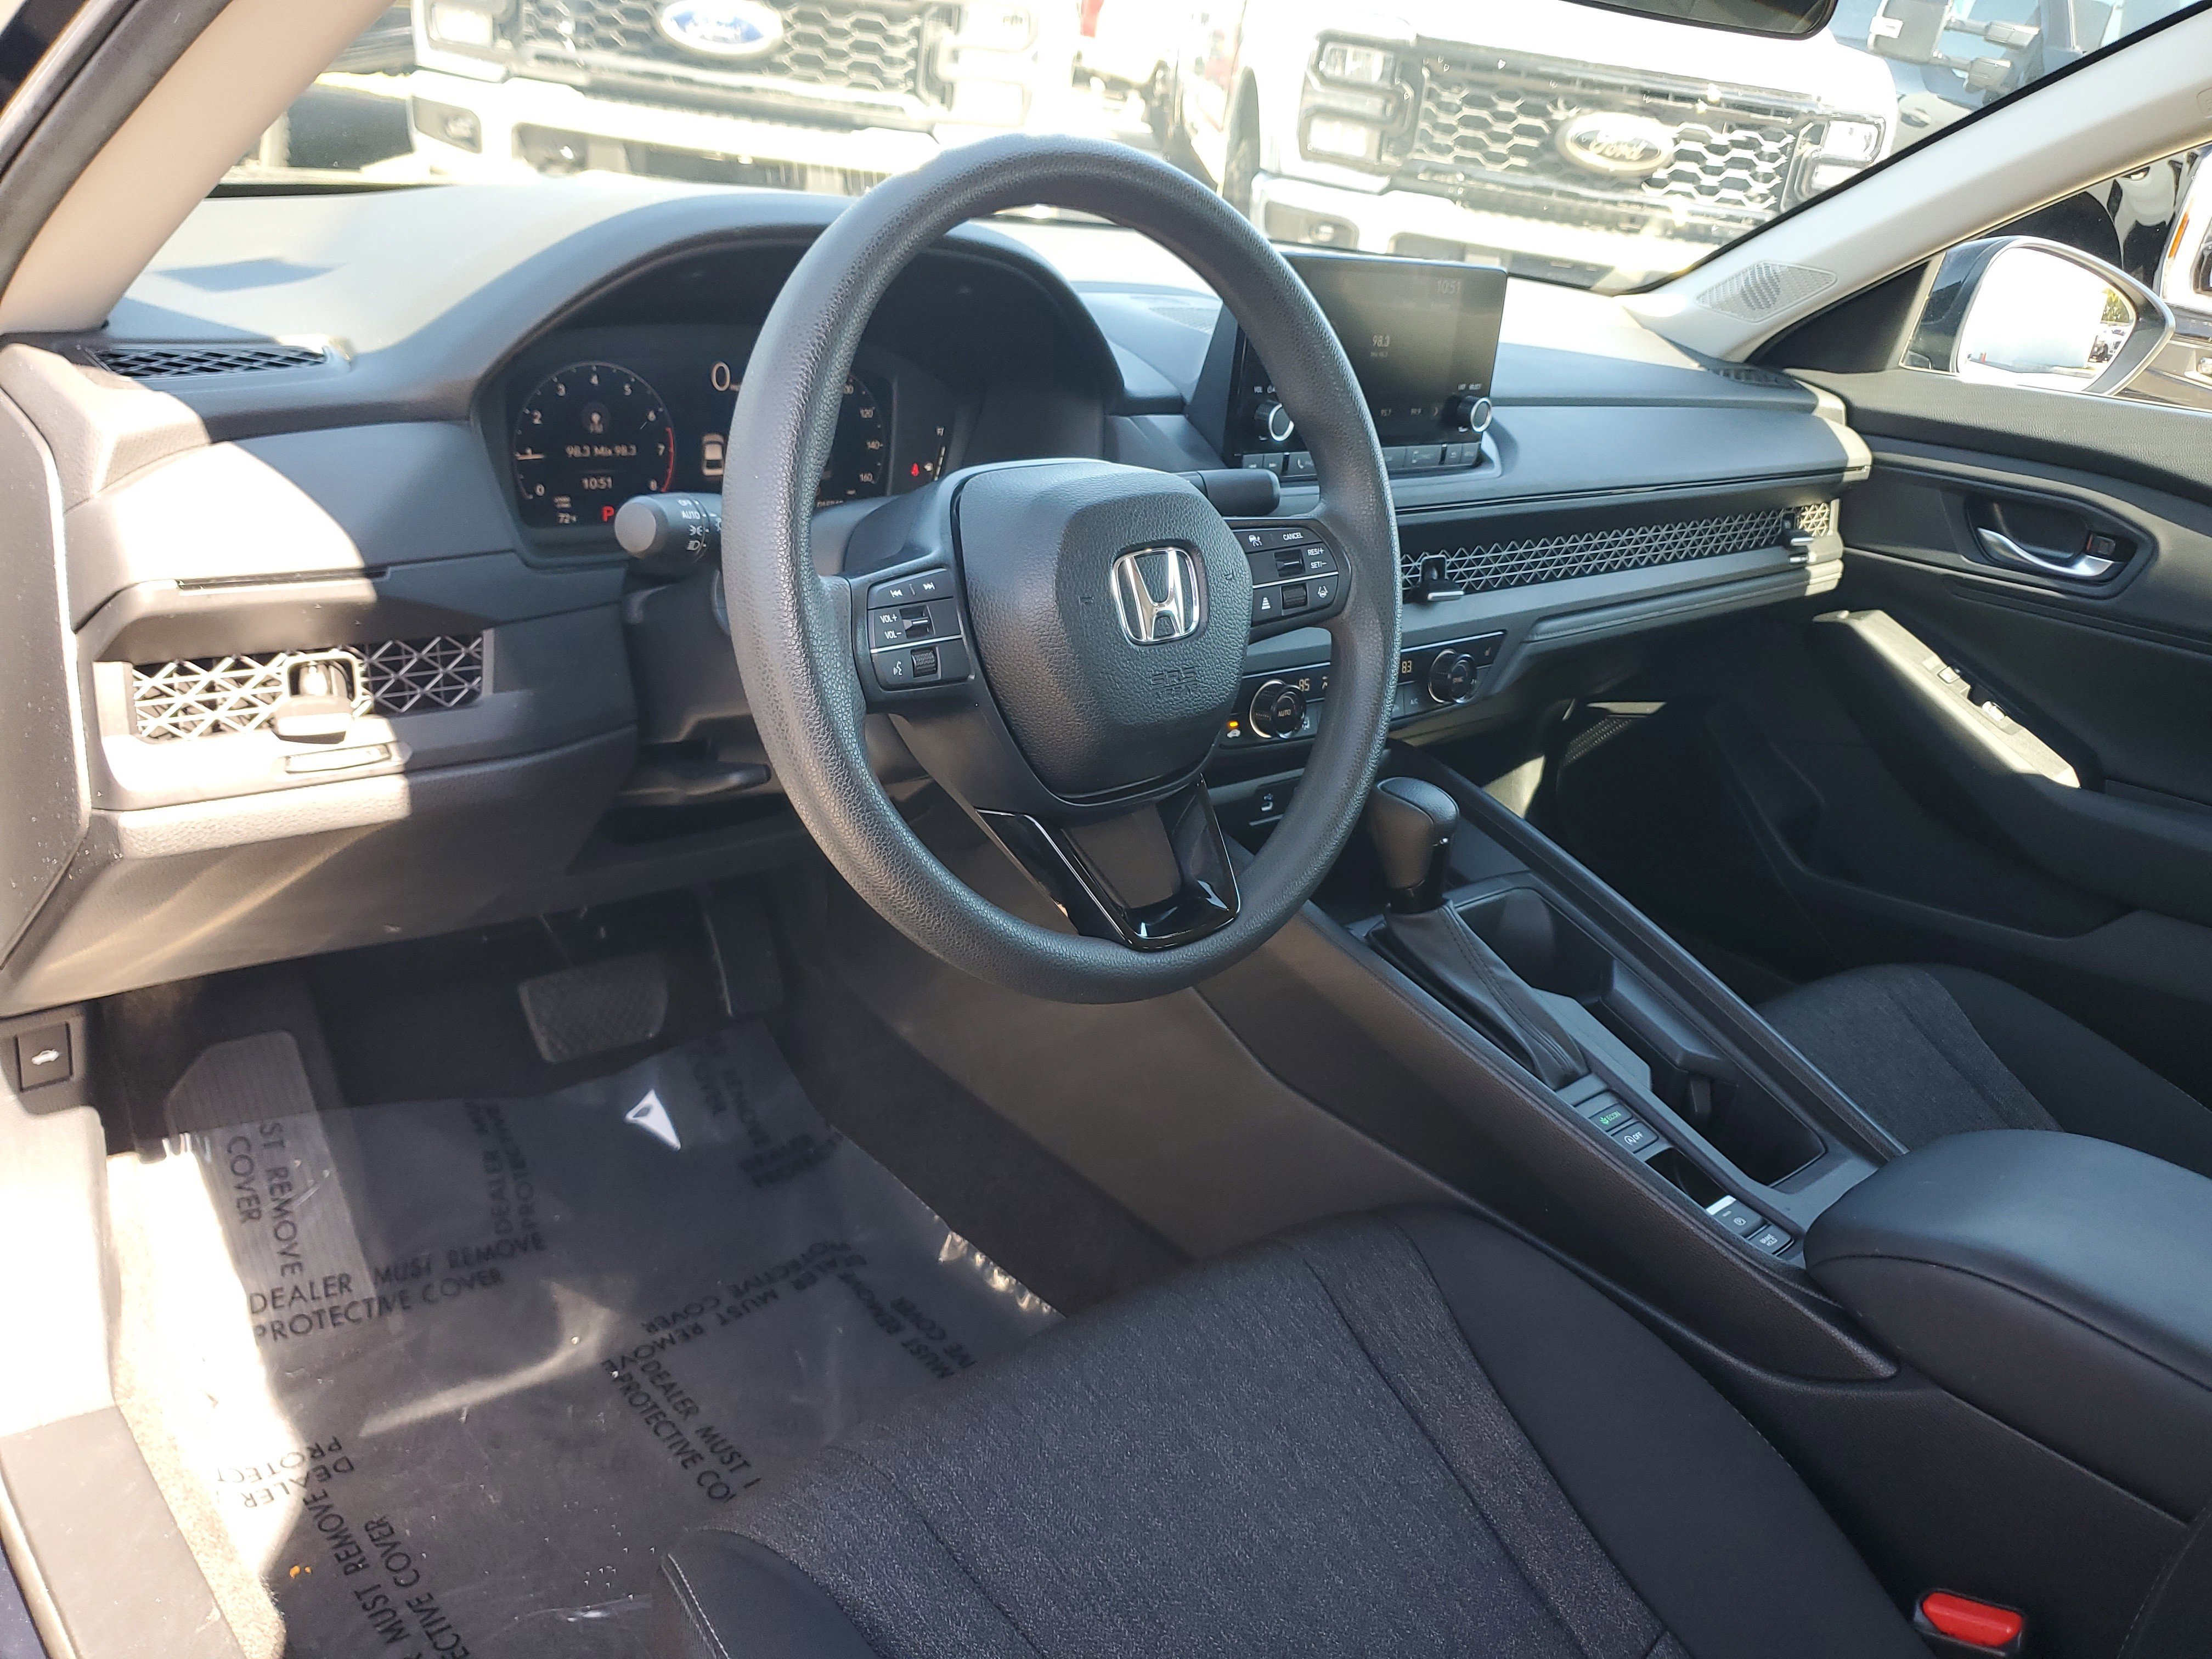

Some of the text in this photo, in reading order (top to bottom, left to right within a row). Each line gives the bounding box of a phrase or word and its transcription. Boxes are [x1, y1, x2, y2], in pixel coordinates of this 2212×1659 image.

[711, 362, 731, 391] 0
[602, 505, 615, 522] P
[681, 510, 701, 520] AUTO
[1283, 532, 1304, 541] CANCEL
[1401, 660, 1412, 674] 83
[1278, 709, 1291, 717] AUTO
[227, 1135, 262, 1224] COVER
[266, 1166, 303, 1278] REMOVE
[250, 1231, 547, 1314] DEALER MUST REMOVE
[253, 1267, 504, 1342] PROTECTIVE COVER
[641, 1294, 721, 1335] COVER
[715, 1288, 779, 1327] MUST
[613, 1372, 704, 1470] PROTECTIVE
[640, 1361, 751, 1472] DEALER MUST
[240, 1455, 354, 1508] DEALER
[302, 1488, 412, 1644] MUST REMOVE
[364, 1516, 421, 1588] COVER
